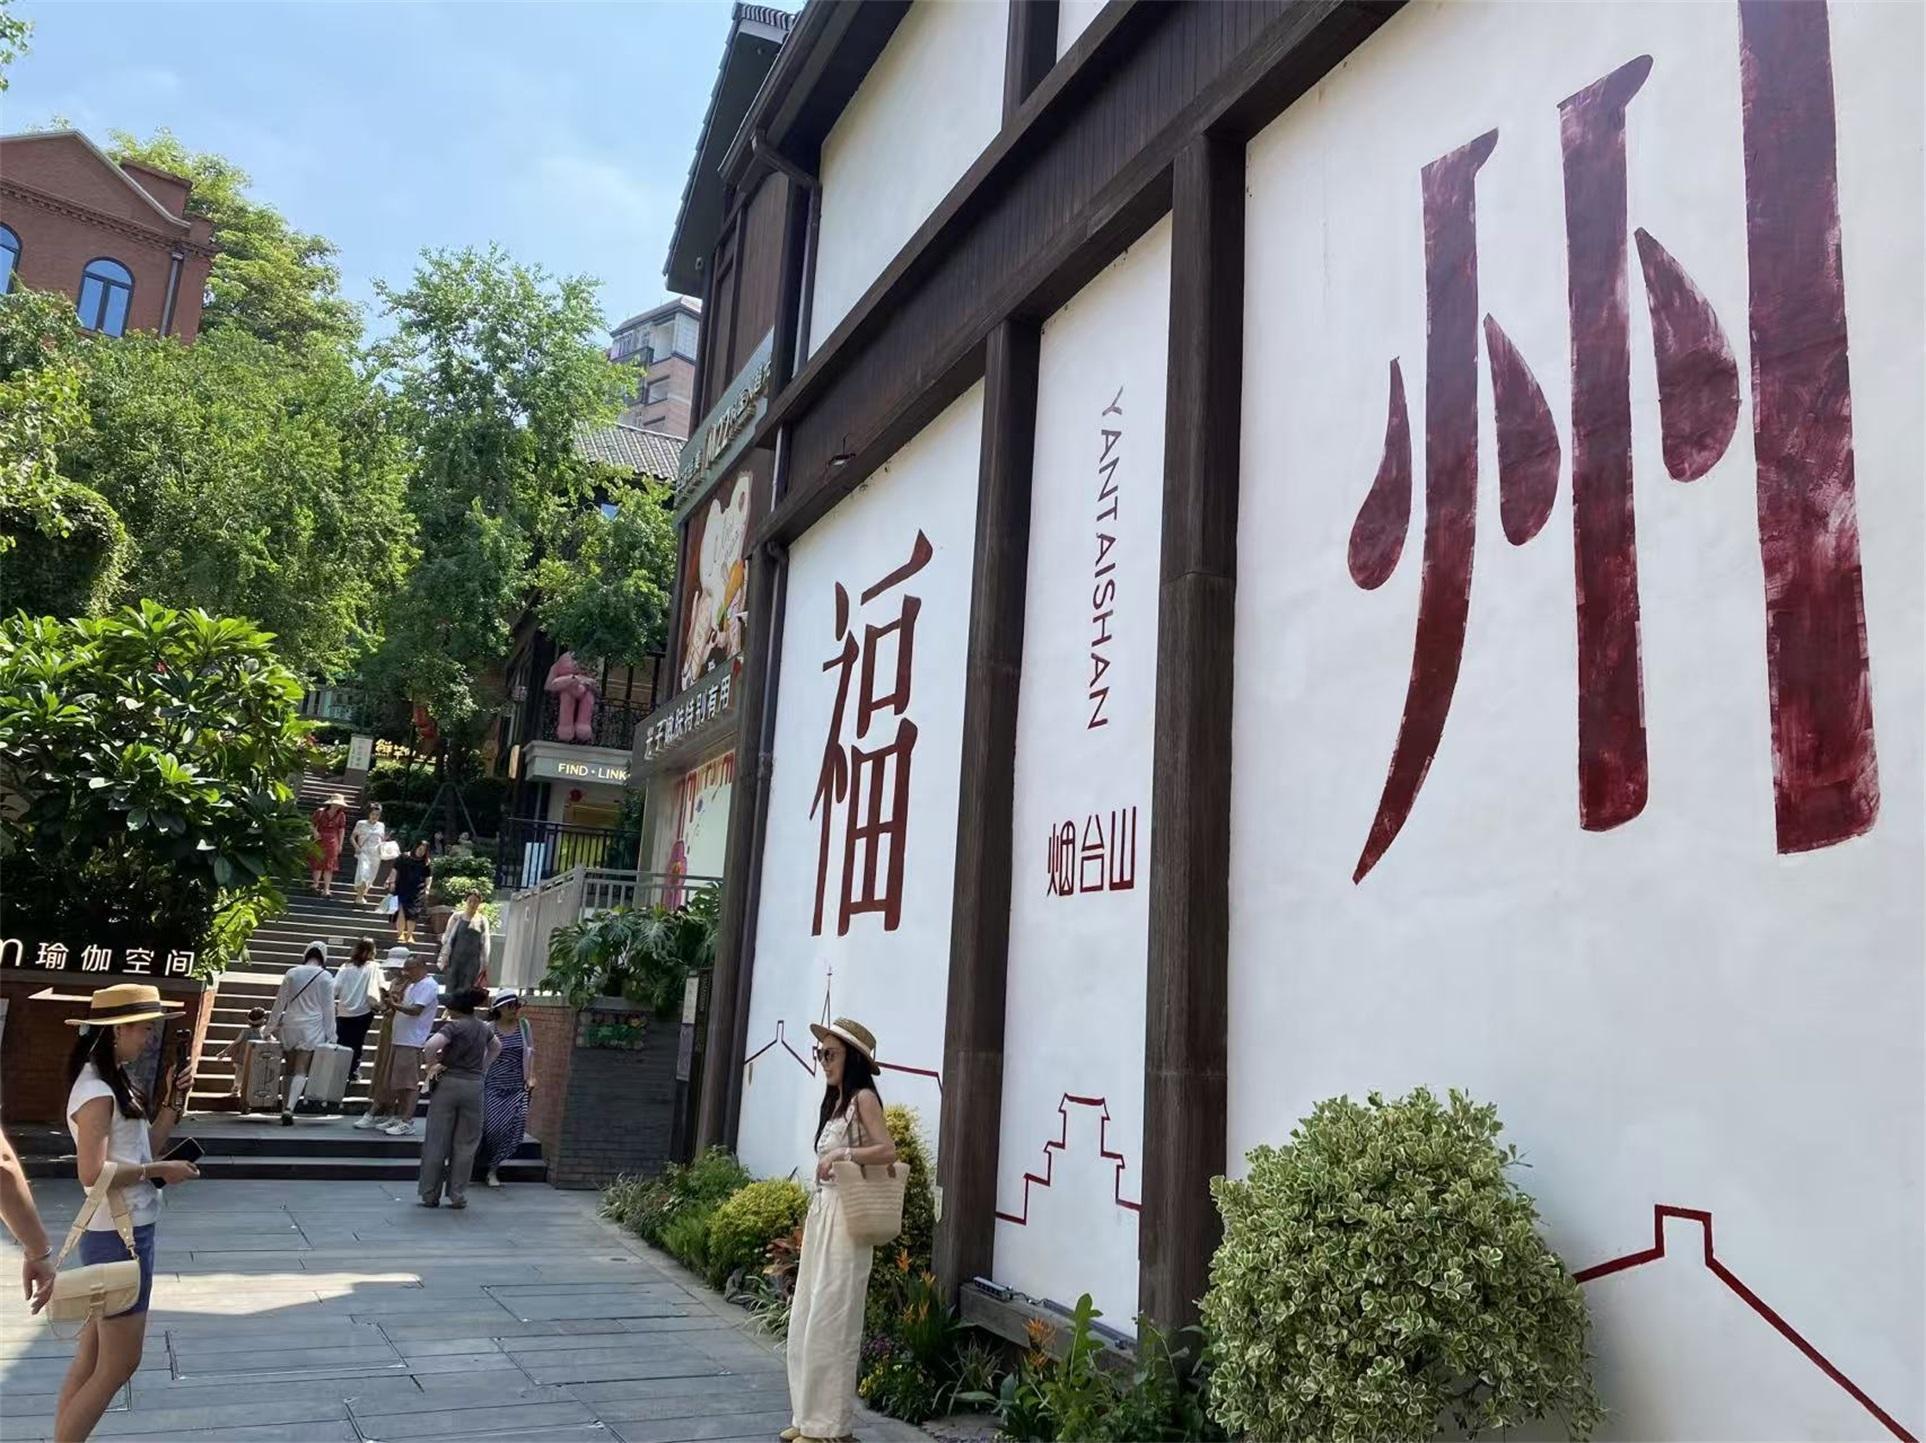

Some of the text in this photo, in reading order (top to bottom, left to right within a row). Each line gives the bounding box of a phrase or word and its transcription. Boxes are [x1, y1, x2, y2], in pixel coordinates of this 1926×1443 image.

[1347, 0, 1881, 884] 州
[1087, 385, 1123, 731] YANTAISHAN
[558, 763, 627, 780] FIND LINK
[809, 528, 934, 937] 福
[35, 942, 195, 977] 瑜伽空间
[1046, 805, 1137, 897] 烟台山
